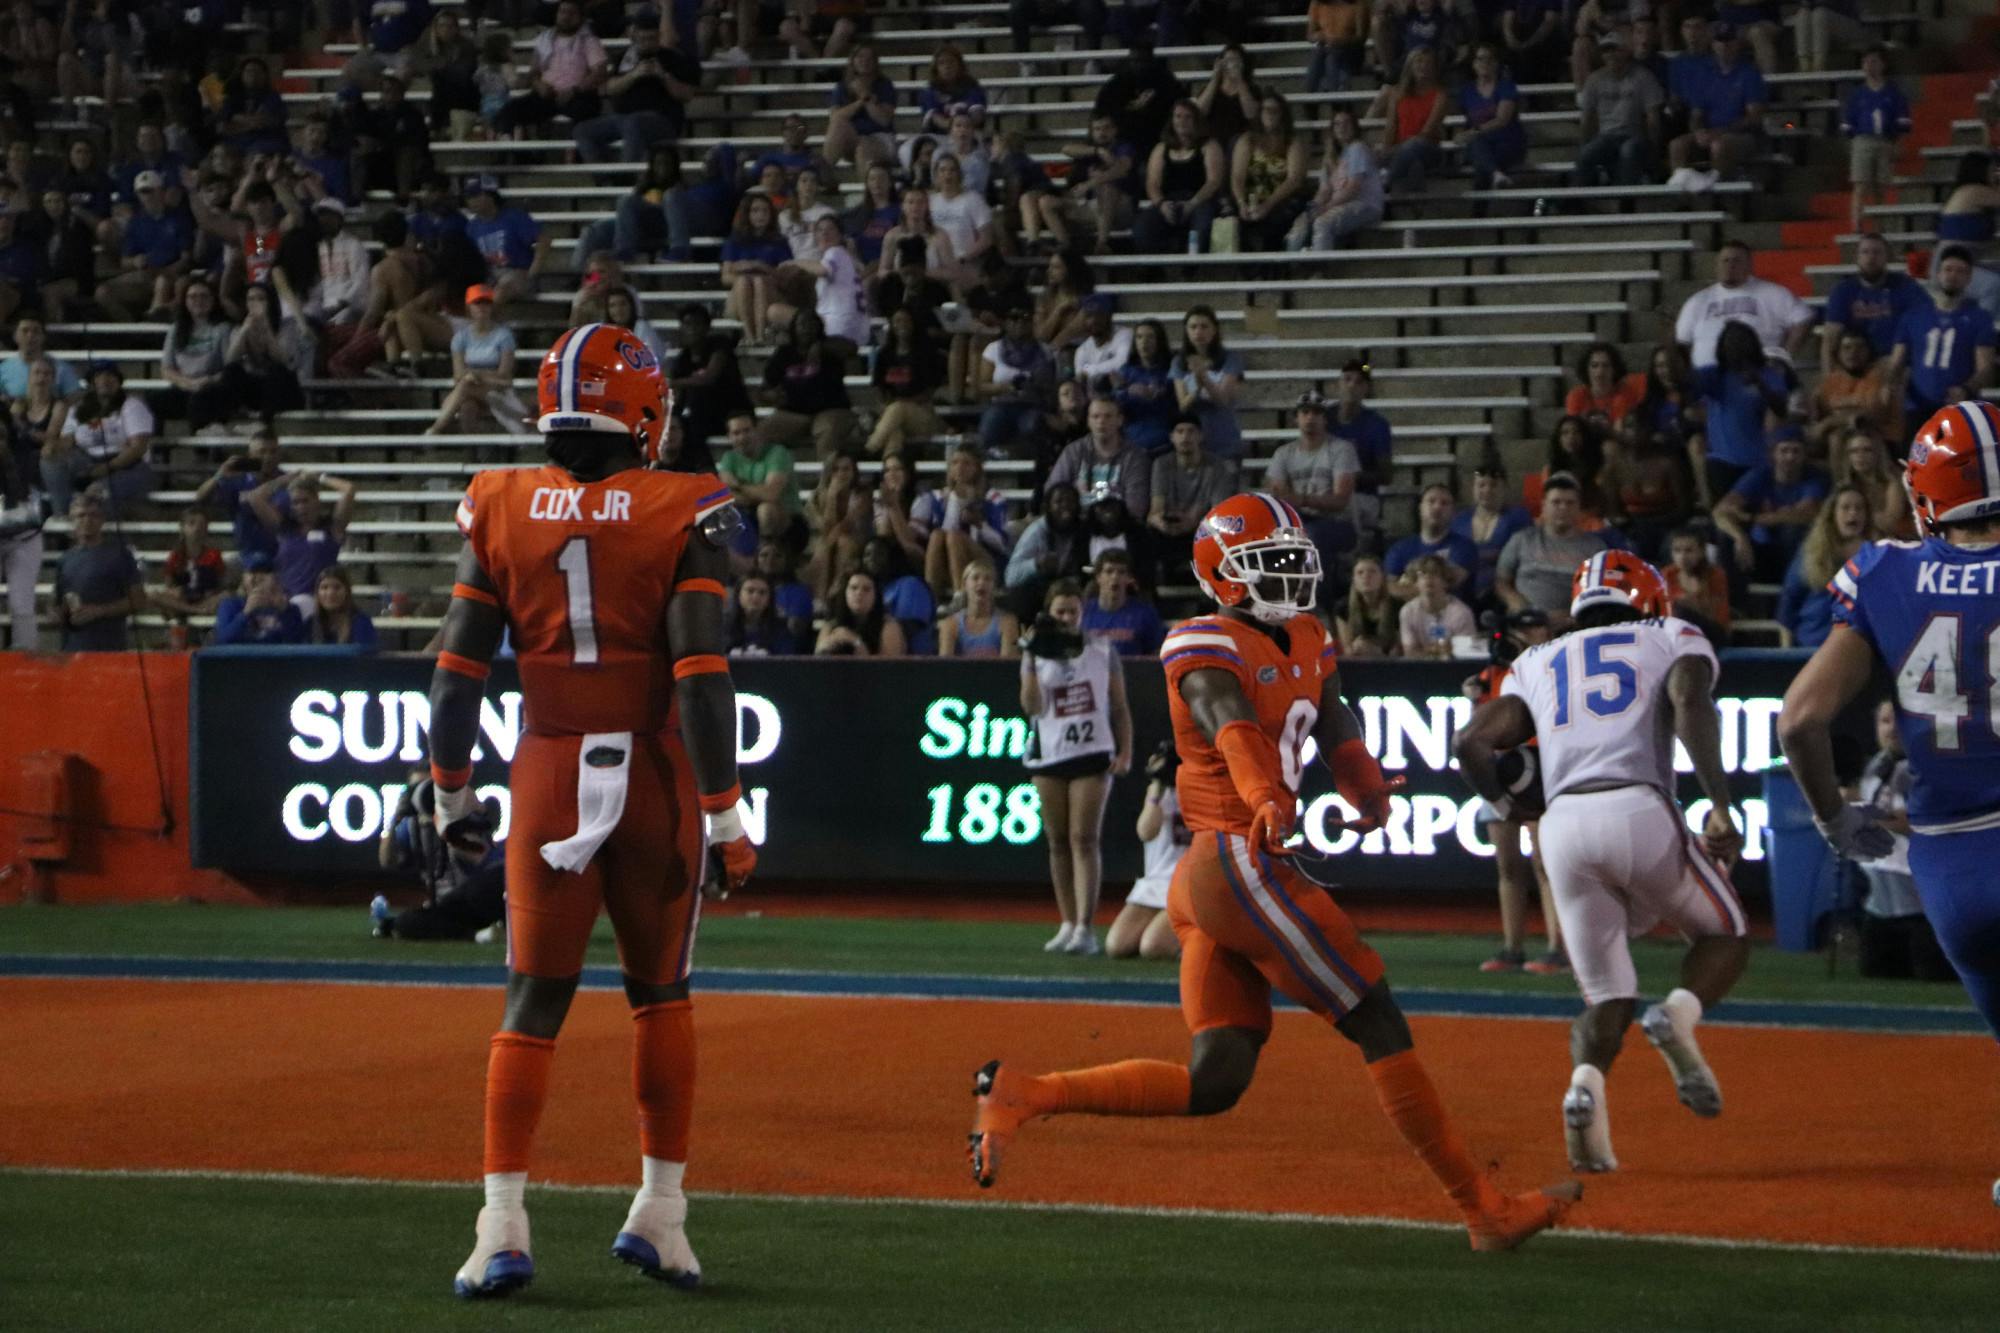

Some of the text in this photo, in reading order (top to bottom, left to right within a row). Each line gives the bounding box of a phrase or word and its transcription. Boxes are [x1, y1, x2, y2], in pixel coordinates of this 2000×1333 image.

[1924, 327, 1957, 370] 11
[529, 487, 632, 521] COX JR
[556, 537, 599, 665] 1
[1549, 632, 1638, 728] 15
[1896, 614, 2000, 750] 4
[920, 696, 1036, 759] Sin
[1066, 720, 1095, 745] 42
[1278, 698, 1319, 793] 0
[921, 782, 1044, 844] 188
